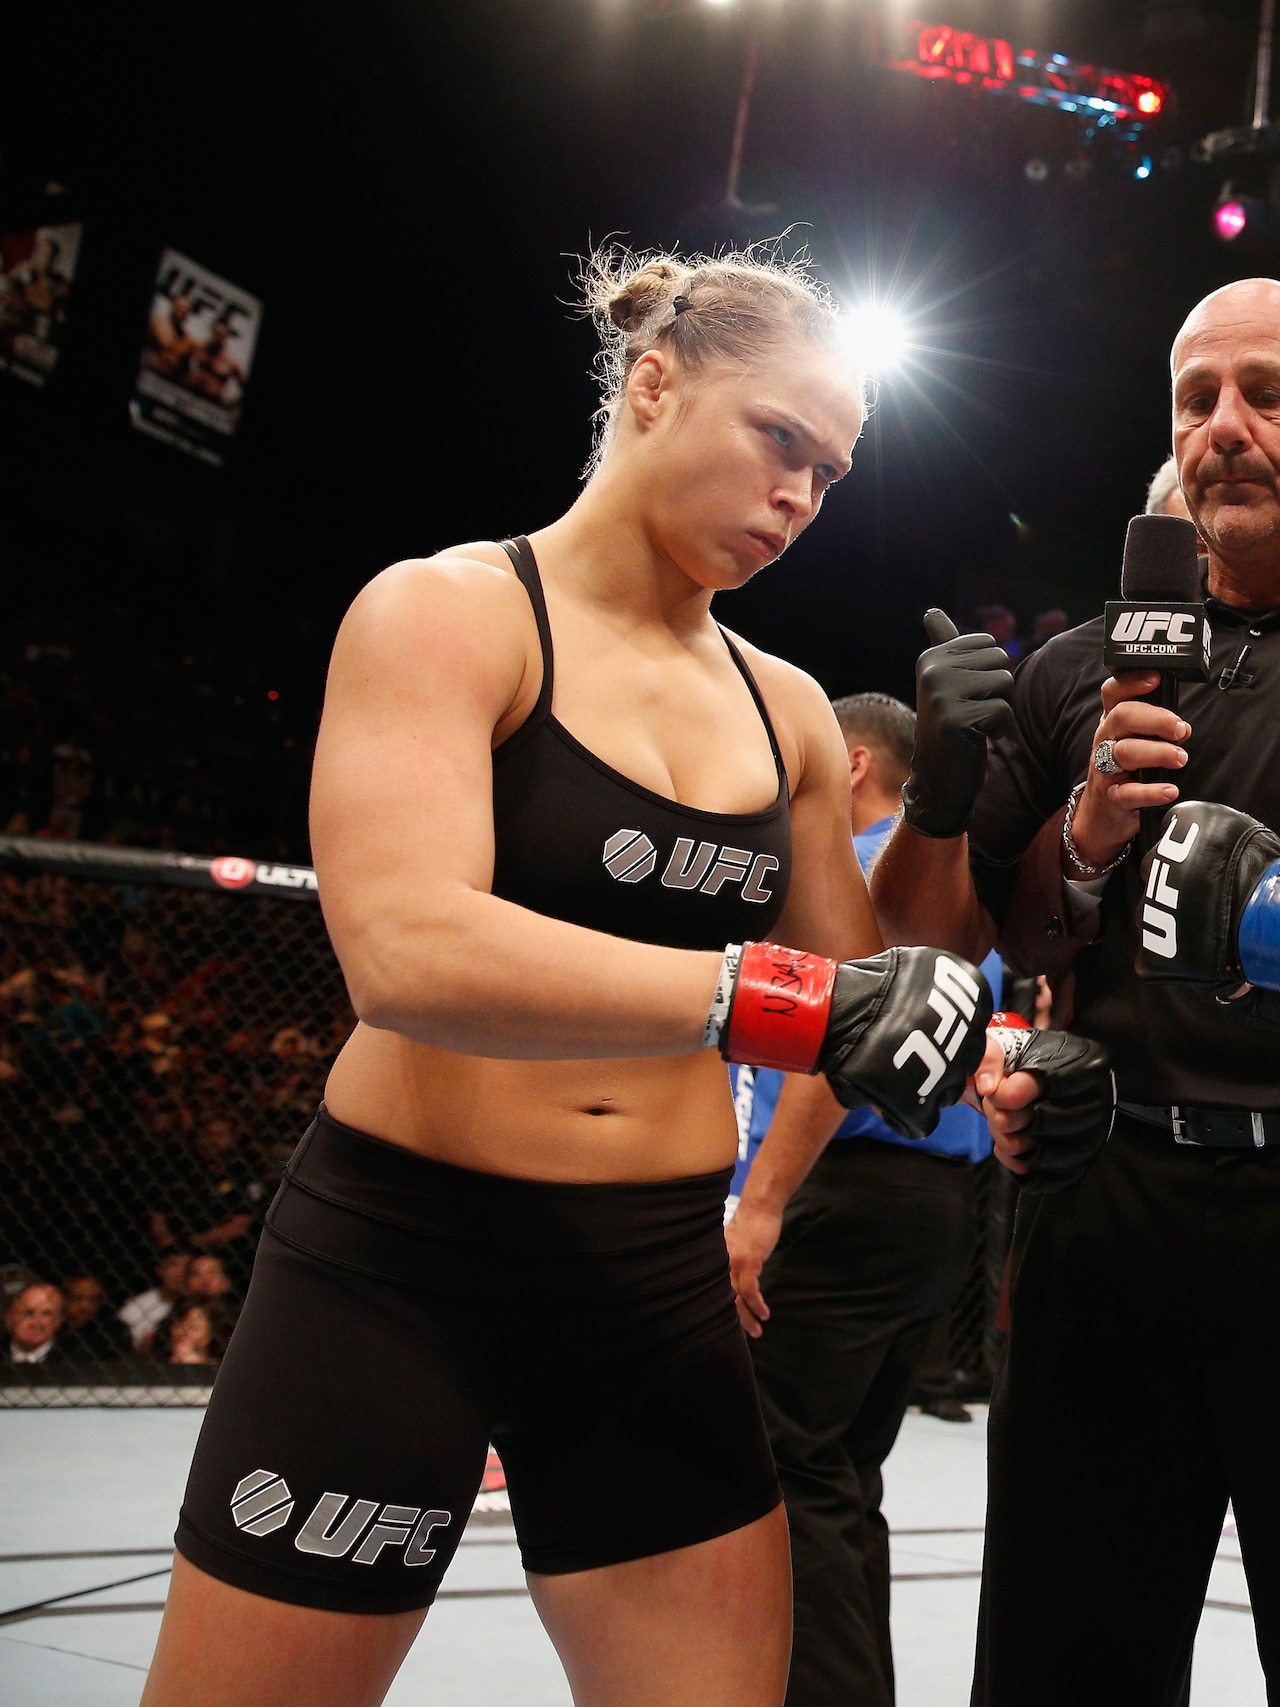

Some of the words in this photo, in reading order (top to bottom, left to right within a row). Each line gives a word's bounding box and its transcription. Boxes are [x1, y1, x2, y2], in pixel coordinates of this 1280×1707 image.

[1110, 611, 1196, 643] UFC
[1125, 644, 1178, 654] UFC.COM
[660, 836, 780, 903] UFC
[1142, 816, 1200, 959] UFC
[892, 955, 980, 1098] UFC
[294, 1491, 452, 1567] UFC
